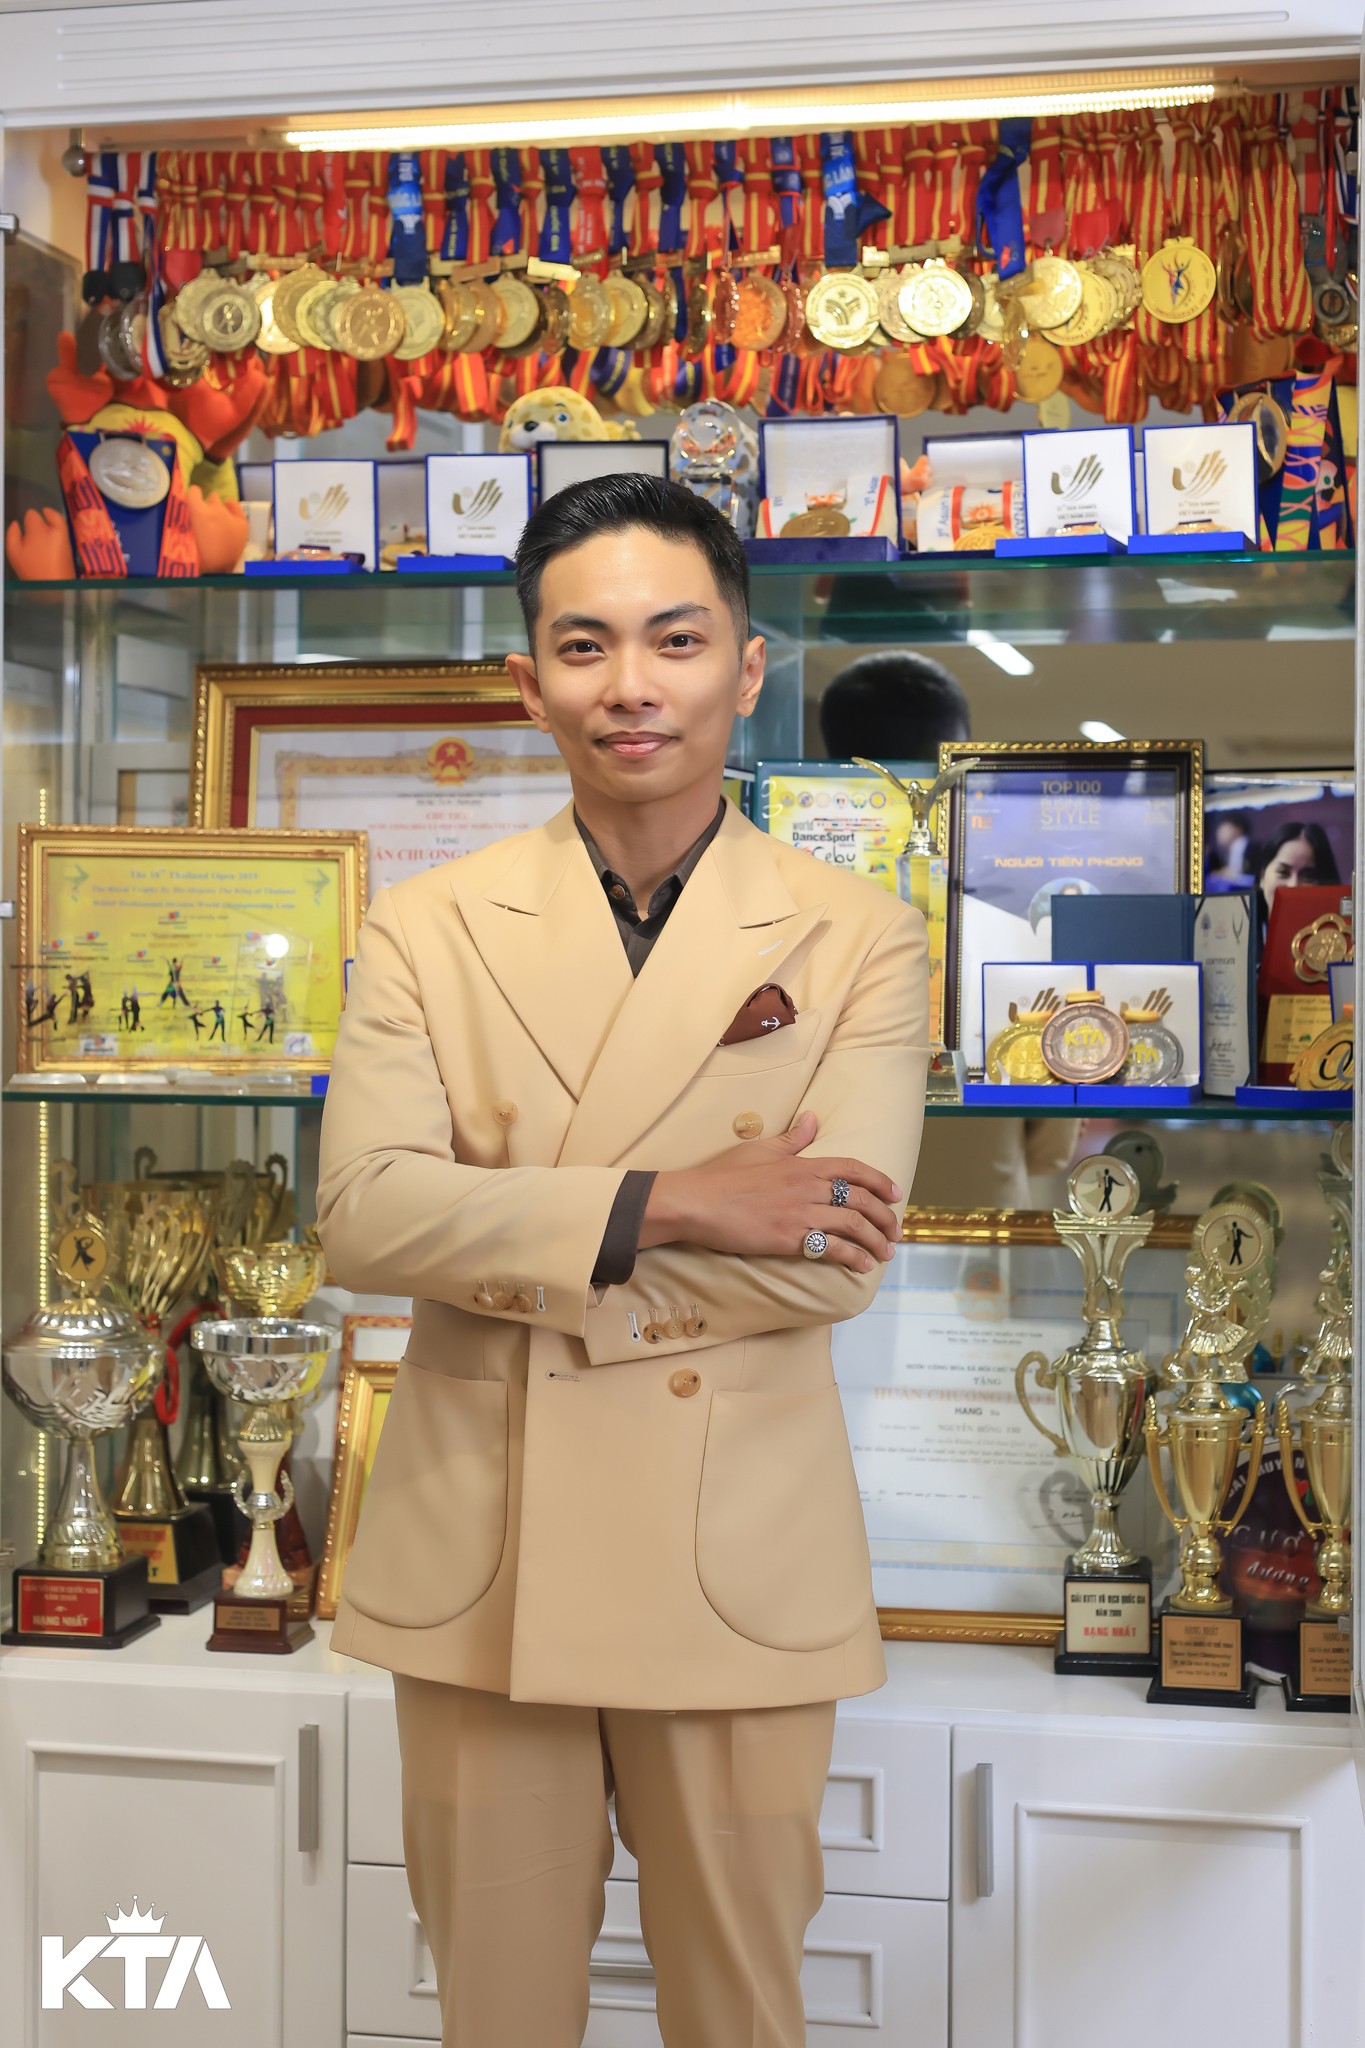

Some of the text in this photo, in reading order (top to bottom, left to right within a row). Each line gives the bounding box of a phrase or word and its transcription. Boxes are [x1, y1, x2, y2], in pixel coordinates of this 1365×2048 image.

[1041, 780, 1101, 795] TOP 100
[1041, 808, 1100, 825] STYLE
[792, 832, 855, 843] DanceSport
[1087, 856, 1144, 867] PHONG
